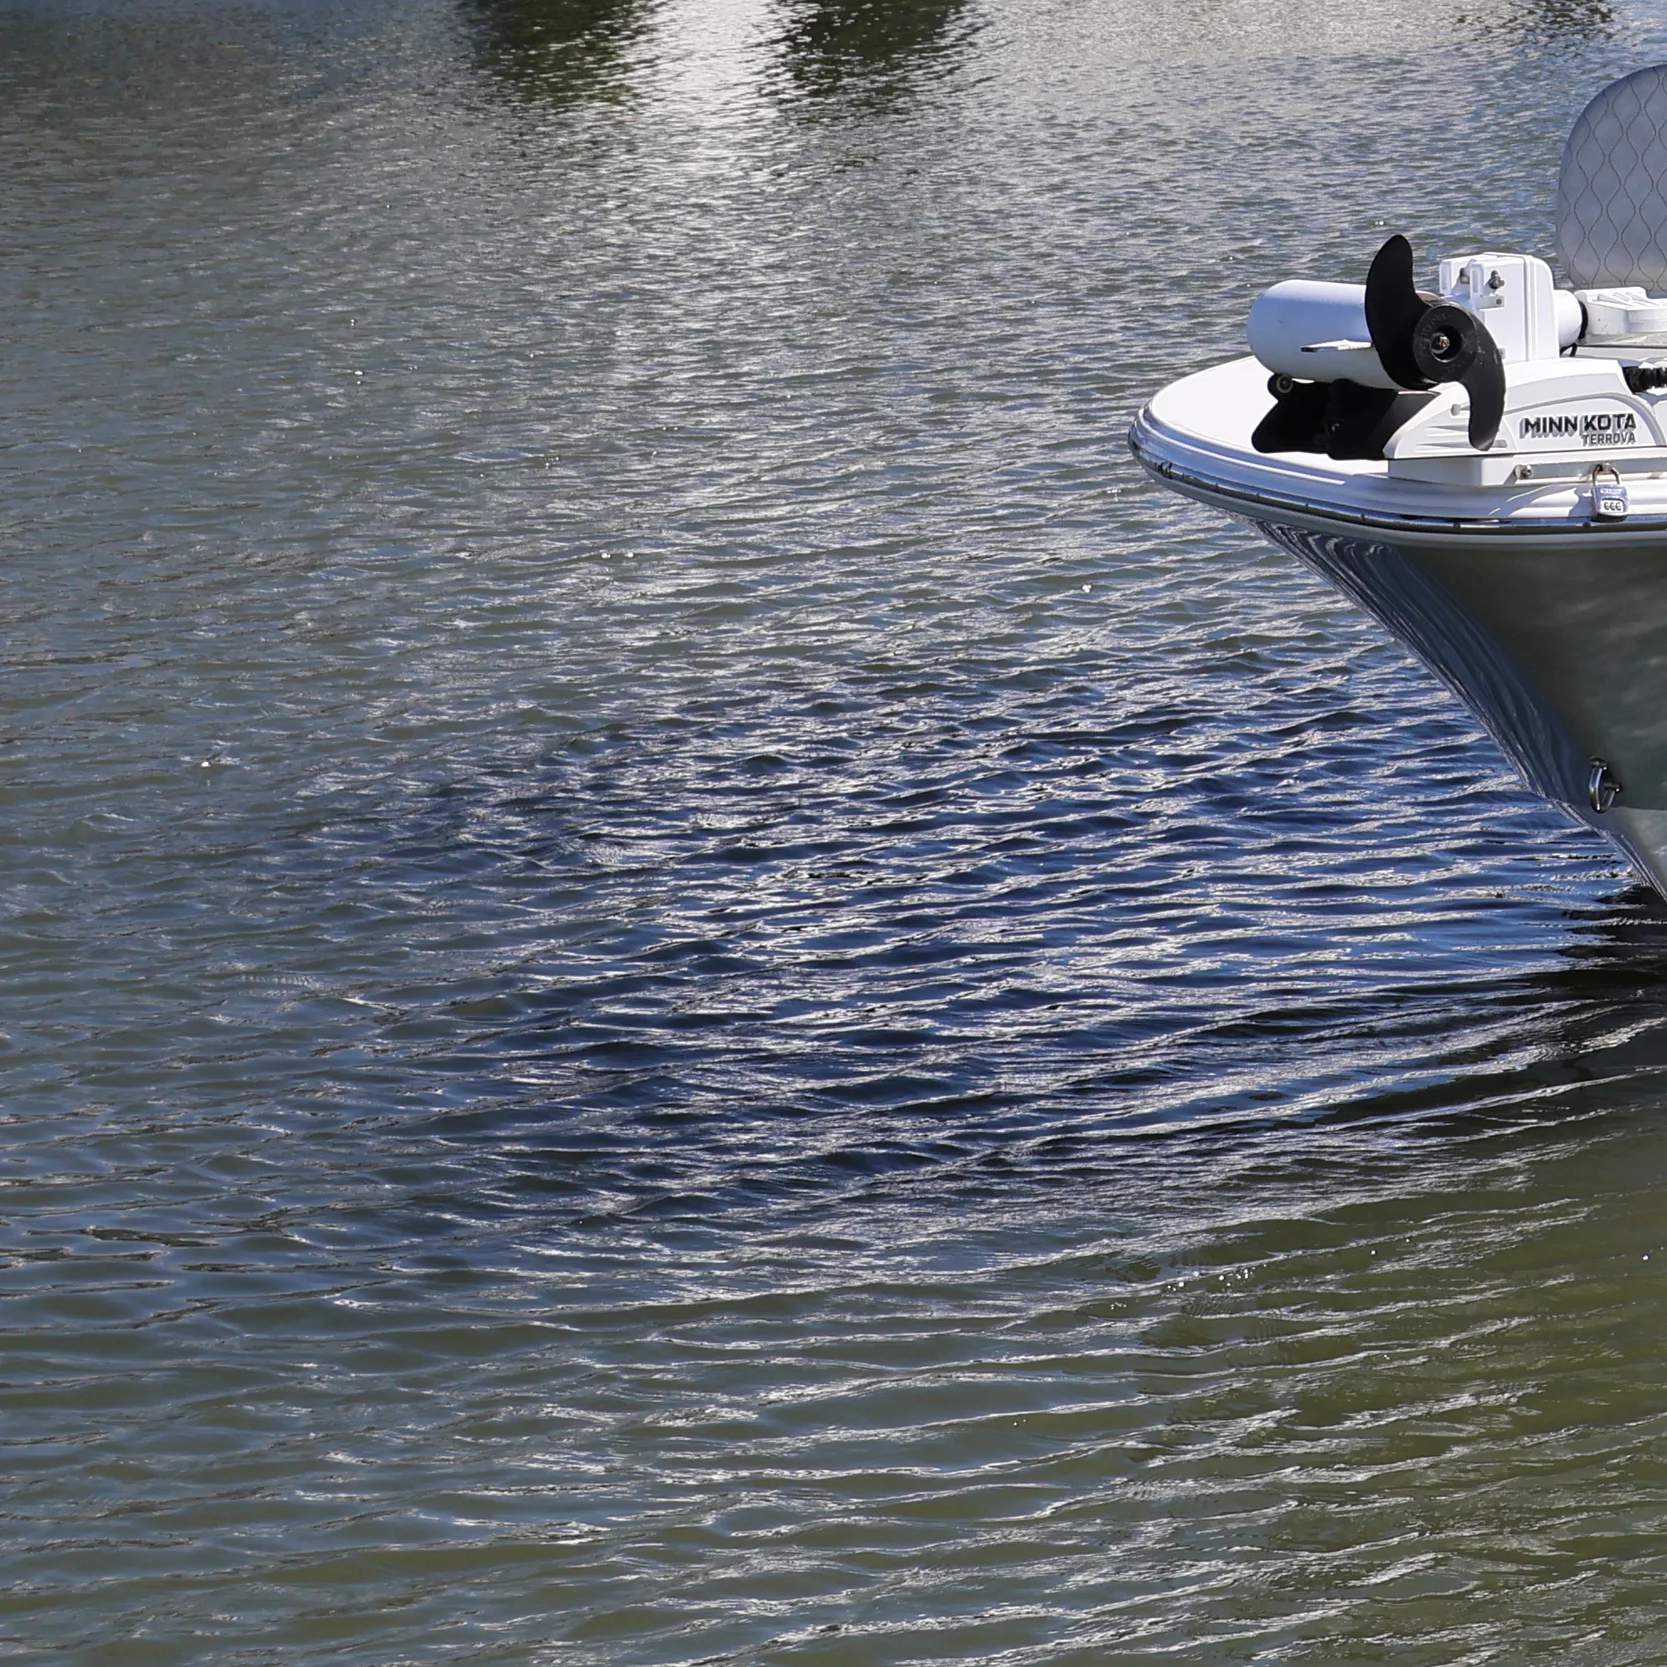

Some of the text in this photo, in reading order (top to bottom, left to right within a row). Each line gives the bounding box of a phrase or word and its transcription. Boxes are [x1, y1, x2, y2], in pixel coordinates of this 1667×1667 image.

[1522, 413, 1637, 436] MINN KOTA
[1581, 432, 1636, 446] TERROVA
